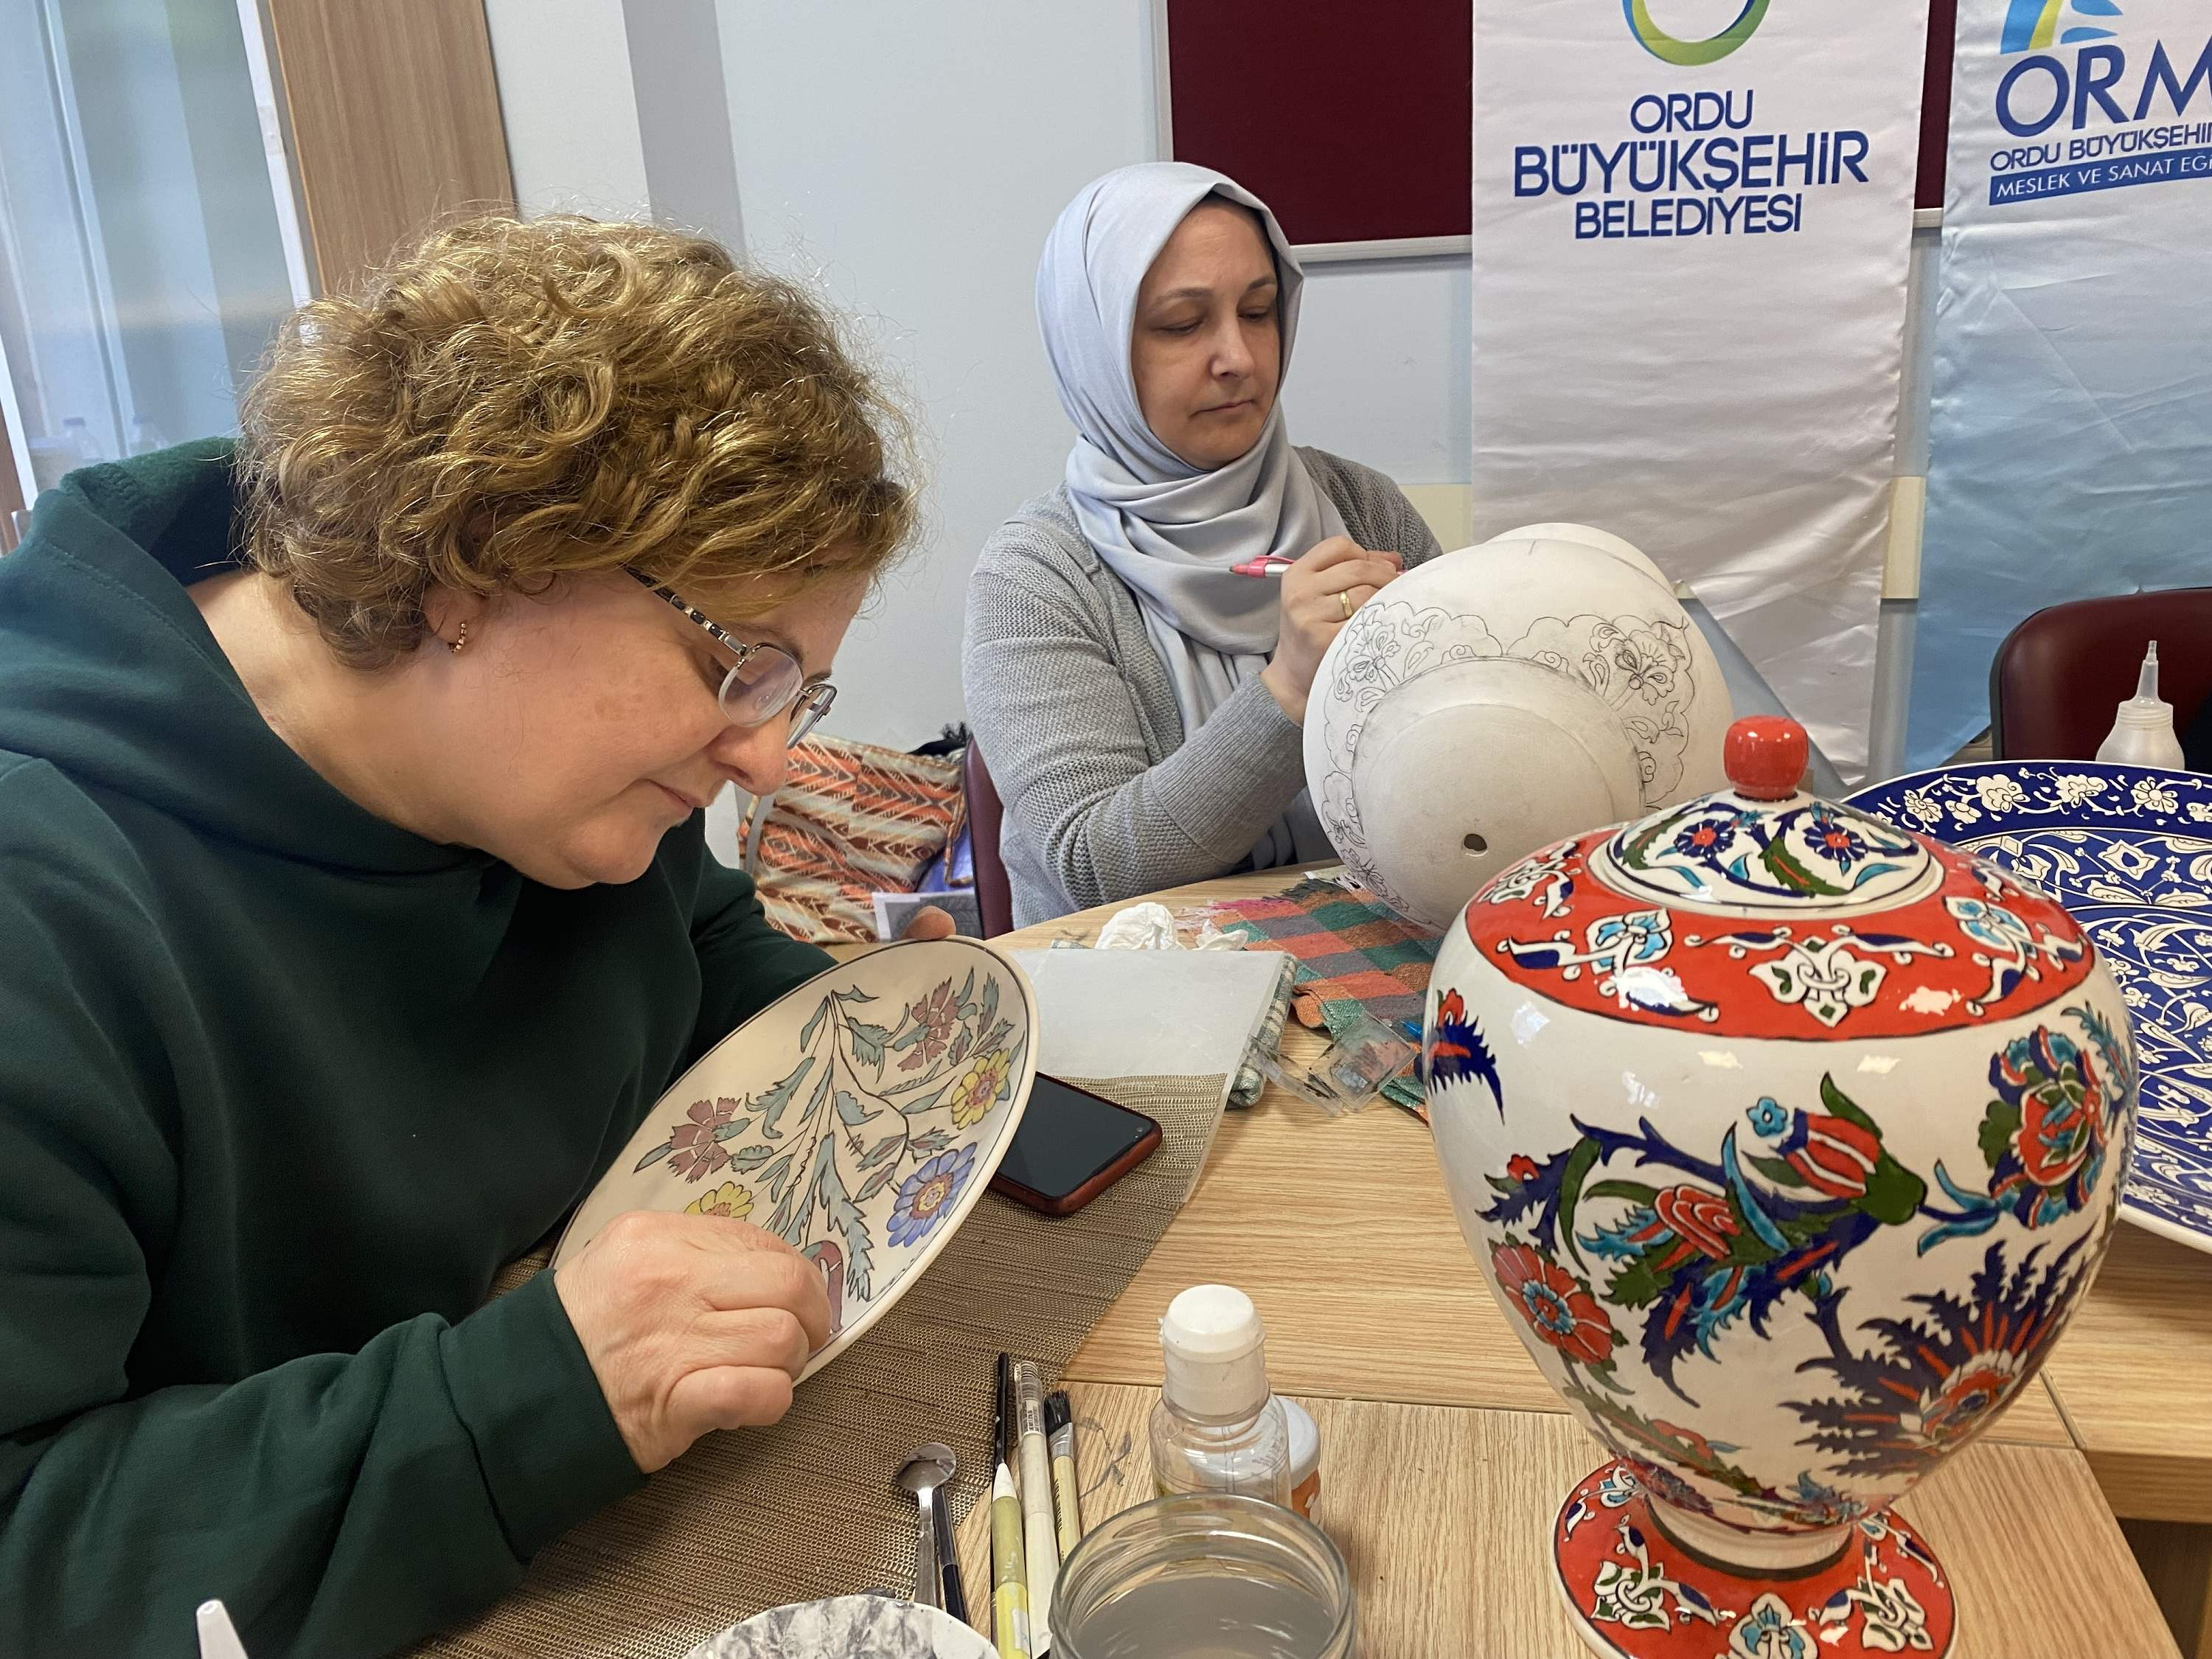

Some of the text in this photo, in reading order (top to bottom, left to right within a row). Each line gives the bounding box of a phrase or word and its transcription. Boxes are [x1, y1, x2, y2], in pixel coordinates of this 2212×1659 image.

[1630, 89, 1753, 133] ORDU
[1991, 142, 2061, 171] ORDU
[1997, 173, 2070, 198] MESLEK
[2078, 167, 2101, 185] VE
[2108, 158, 2174, 181] SANAT
